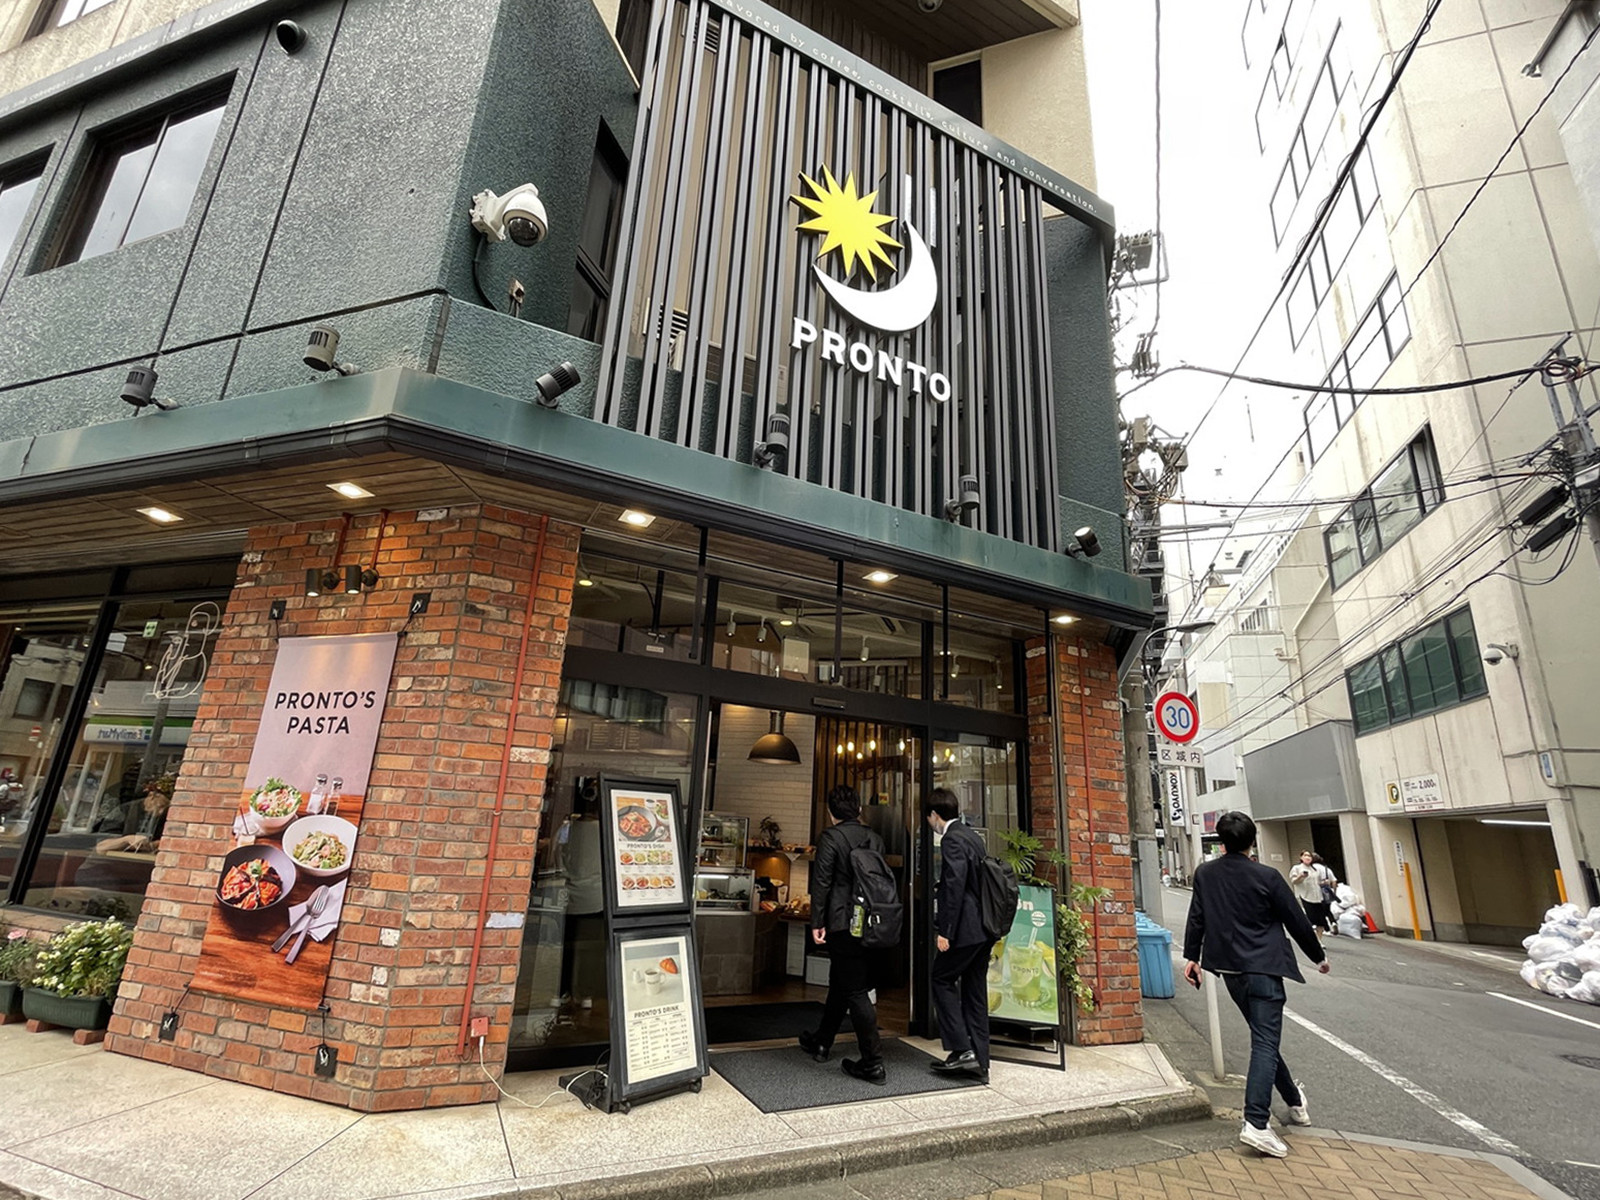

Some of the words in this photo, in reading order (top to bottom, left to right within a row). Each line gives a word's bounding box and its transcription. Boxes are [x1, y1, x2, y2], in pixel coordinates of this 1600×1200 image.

[790, 32, 805, 48] by
[941, 120, 989, 152] culture
[996, 151, 1016, 167] and
[1022, 166, 1098, 214] conversation.
[790, 316, 951, 403] PRONTO
[274, 690, 376, 709] PRONTO'S
[286, 716, 350, 734] PASTA
[1166, 705, 1190, 729] 30
[1169, 772, 1181, 809] KOKUYO
